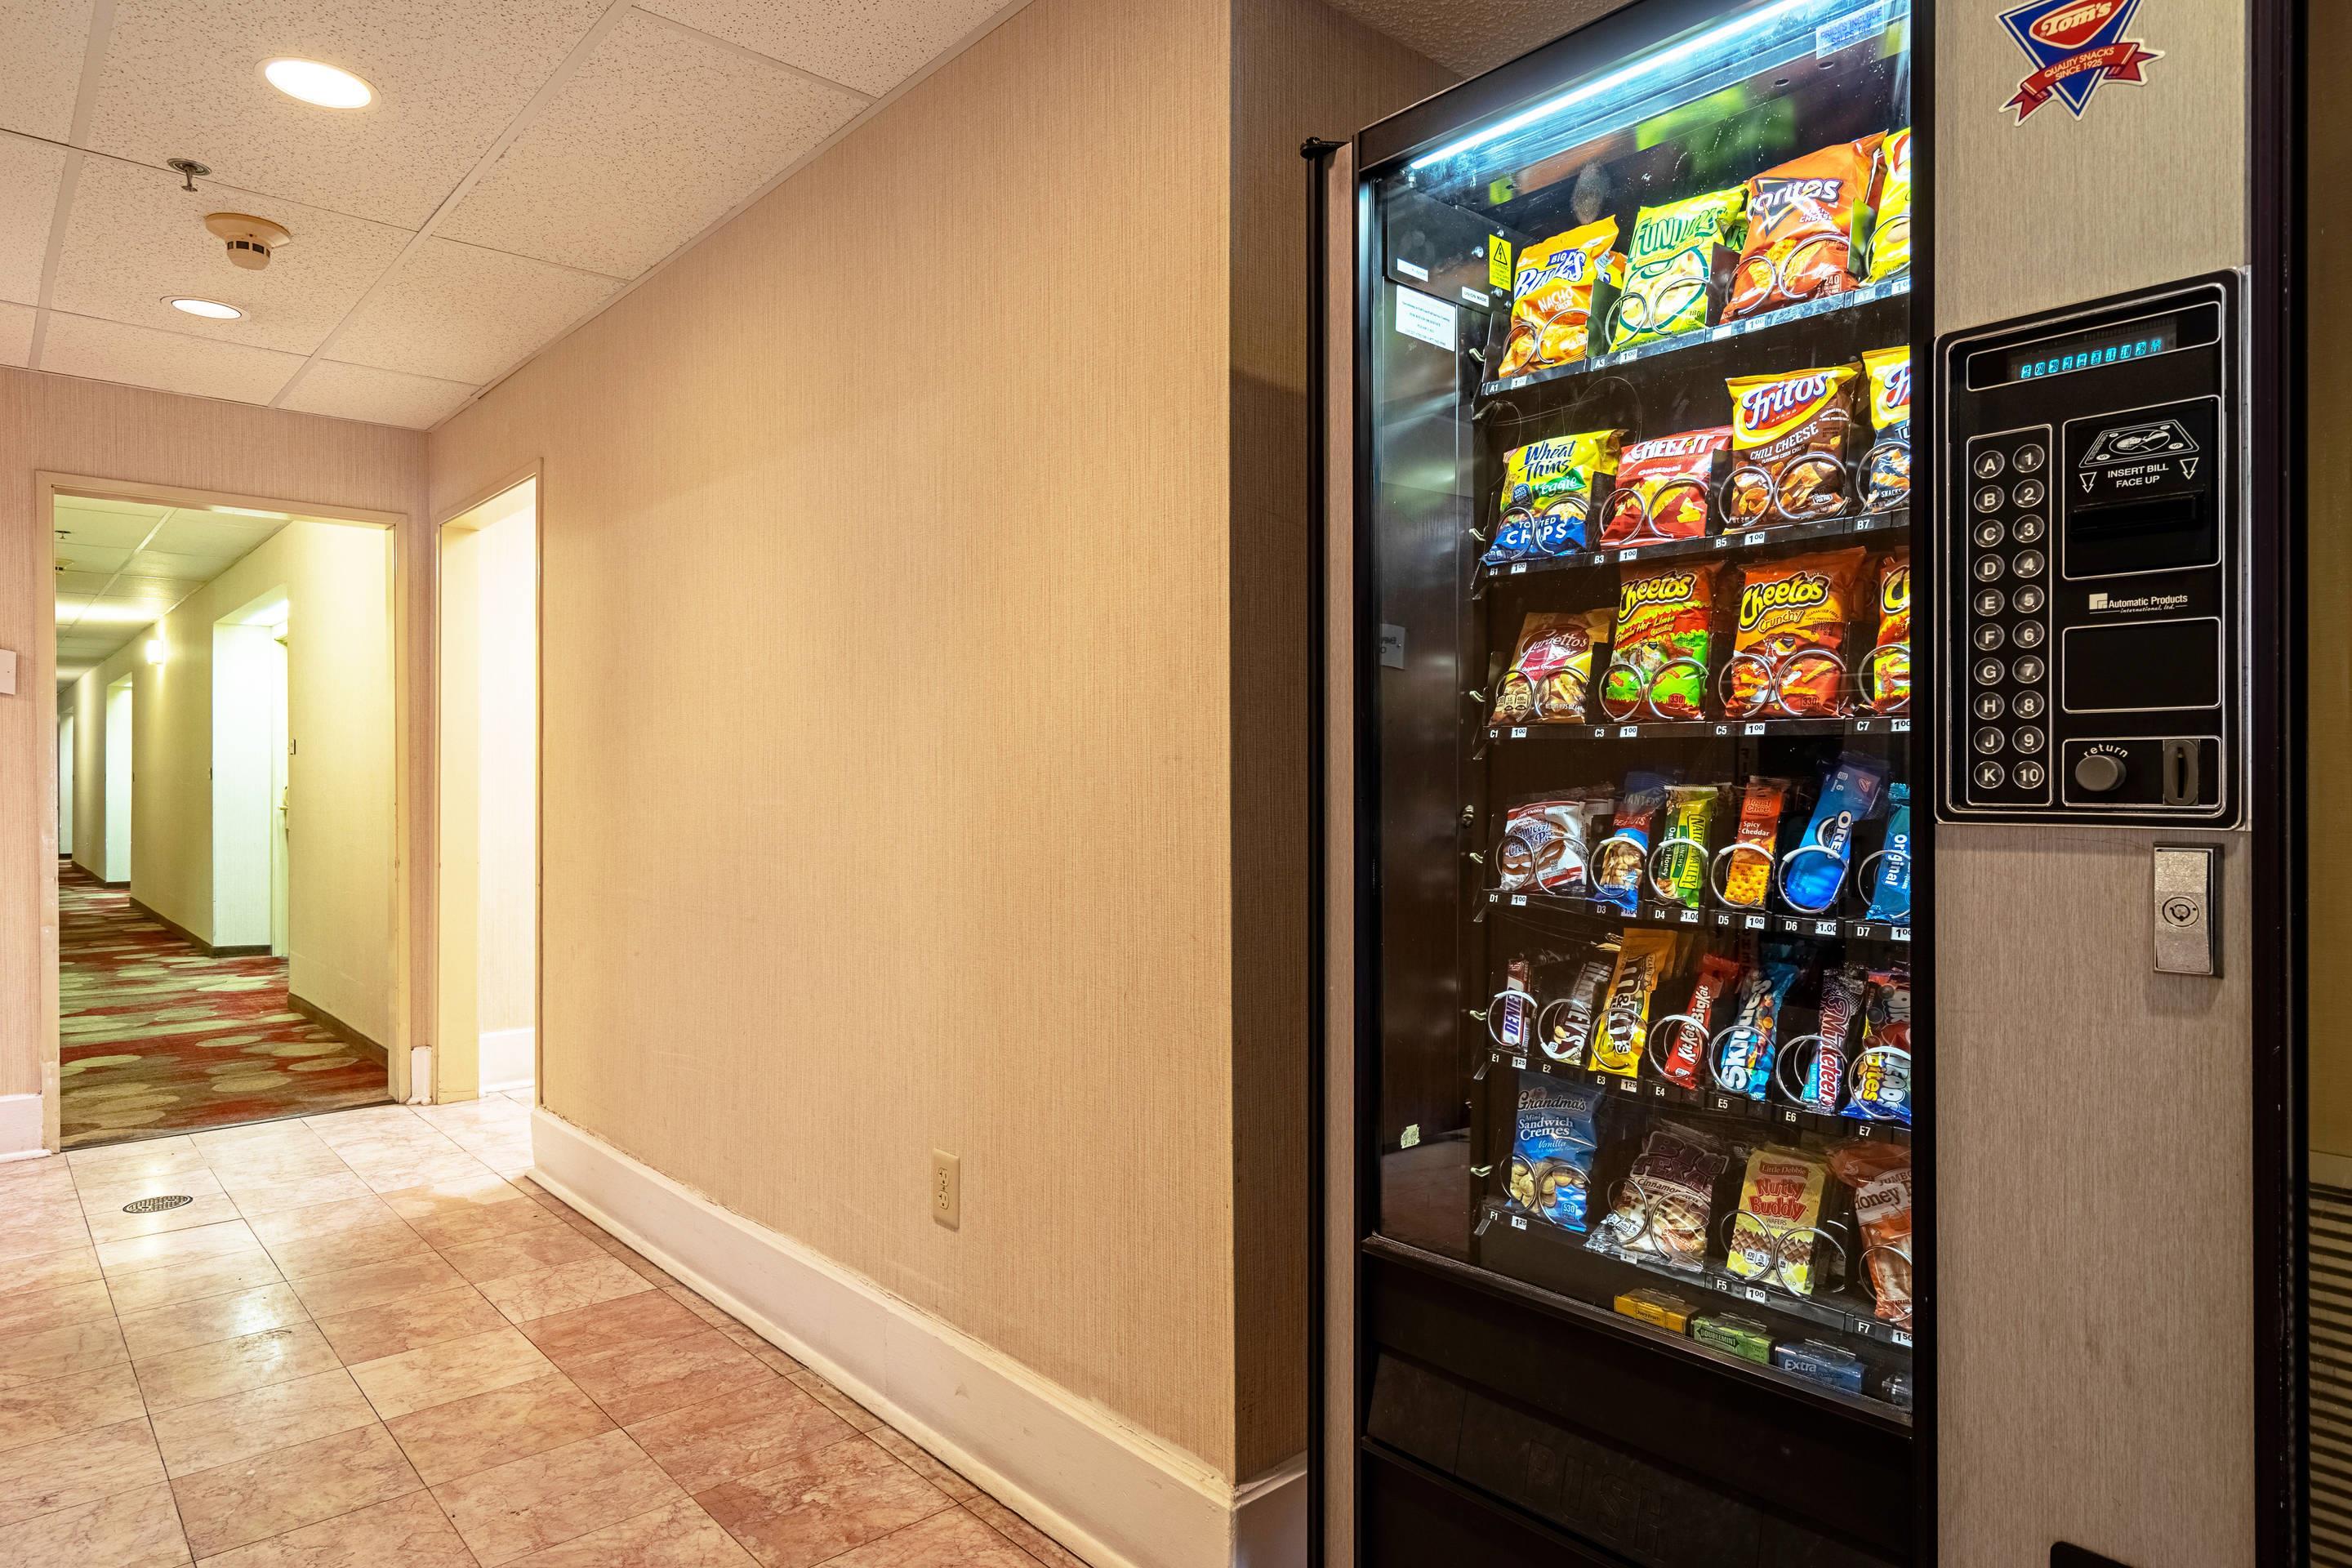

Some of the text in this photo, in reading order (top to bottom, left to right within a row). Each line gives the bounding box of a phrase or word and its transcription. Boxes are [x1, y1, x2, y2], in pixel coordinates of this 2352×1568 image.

[2041, 2, 2112, 37] Tom's
[2044, 47, 2114, 78] QUALITY SNACKS
[2056, 59, 2103, 80] SINCE 1925
[1551, 252, 1568, 264] BIG
[1824, 274, 1839, 286] 240
[1477, 295, 1487, 303] MADE
[1537, 287, 1574, 313] NACHO
[1595, 359, 1606, 369] A3
[1490, 385, 1499, 393] A1
[1741, 372, 1829, 430] Fritos
[1749, 421, 1820, 461] CHILI CHEESE
[1524, 440, 1577, 465] Wheat
[2025, 452, 2032, 466] 1
[1518, 459, 1572, 482] Thins
[1984, 458, 1997, 472] A
[2107, 462, 2169, 479] INSERT BILL
[2116, 474, 2160, 488] FACE UP
[1881, 488, 1903, 498] SNACKS
[1984, 492, 1995, 506] B
[2025, 488, 2035, 501] 2
[1519, 517, 1557, 529] TOTED
[1856, 520, 1870, 531] B7
[2024, 523, 2034, 536] 3
[1984, 528, 1996, 541] C
[1716, 537, 1727, 547] B5
[1594, 555, 1604, 564] B3
[2024, 558, 2034, 570] 4
[1984, 562, 1996, 576] D
[1740, 575, 1828, 627] Cheetos
[1984, 596, 1996, 609] E
[2025, 593, 2034, 606] 5
[2108, 595, 2188, 609] Automatic Products
[1757, 610, 1805, 632] Crunchy
[1984, 630, 1996, 644] F
[2024, 628, 2034, 641] 6
[1983, 666, 1996, 679] G
[2025, 663, 2034, 676] 7
[1669, 696, 1684, 704] 330
[1802, 697, 1817, 706] 330
[1984, 700, 1996, 713] H
[2024, 698, 2034, 711] 8
[1595, 728, 1605, 737] C3
[1716, 726, 1727, 734] C5
[1856, 722, 1869, 731] C7
[1490, 730, 1499, 738] C1
[1984, 734, 1994, 747] J
[2024, 733, 2034, 746] 9
[2084, 744, 2129, 758] return
[1984, 768, 1996, 782] K
[2020, 768, 2039, 782] 10
[1744, 821, 1761, 829] Spicy
[1742, 828, 1771, 836] Cheddar
[1677, 835, 1686, 867] CUNCHY
[1663, 853, 1673, 876] Honey
[1490, 894, 1499, 902] D1
[1597, 905, 1606, 914] D3
[1655, 911, 1665, 920] D4
[1718, 915, 1730, 924] D5
[1785, 922, 1797, 931] D6
[1857, 928, 1870, 937] D7
[1491, 1054, 1499, 1062] E1
[1543, 1064, 1551, 1073] E2
[1597, 1076, 1606, 1085] E3
[1655, 1086, 1665, 1097] E4
[1517, 1090, 1588, 1112] Grandma's
[1717, 1098, 1728, 1109] E5
[1518, 1116, 1575, 1130] Sandwich
[1525, 1112, 1541, 1122] Mini
[1785, 1111, 1797, 1122] E6
[1520, 1125, 1570, 1142] Cremes
[1859, 1126, 1871, 1137] E7
[1538, 1139, 1567, 1149] Vanilla
[1762, 1164, 1807, 1176] Little Debbie
[1637, 1178, 1682, 1194] Cinnamon
[1755, 1177, 1806, 1201] Nutty
[1562, 1204, 1576, 1213] 530
[1748, 1196, 1807, 1223] Buddy
[1490, 1210, 1499, 1221] F1
[1766, 1218, 1788, 1226] WAFERS
[1716, 1280, 1727, 1290] F5
[1858, 1321, 1870, 1333] F7
[1784, 1359, 1817, 1372] Extra
[1522, 1437, 1673, 1563] PUSH
